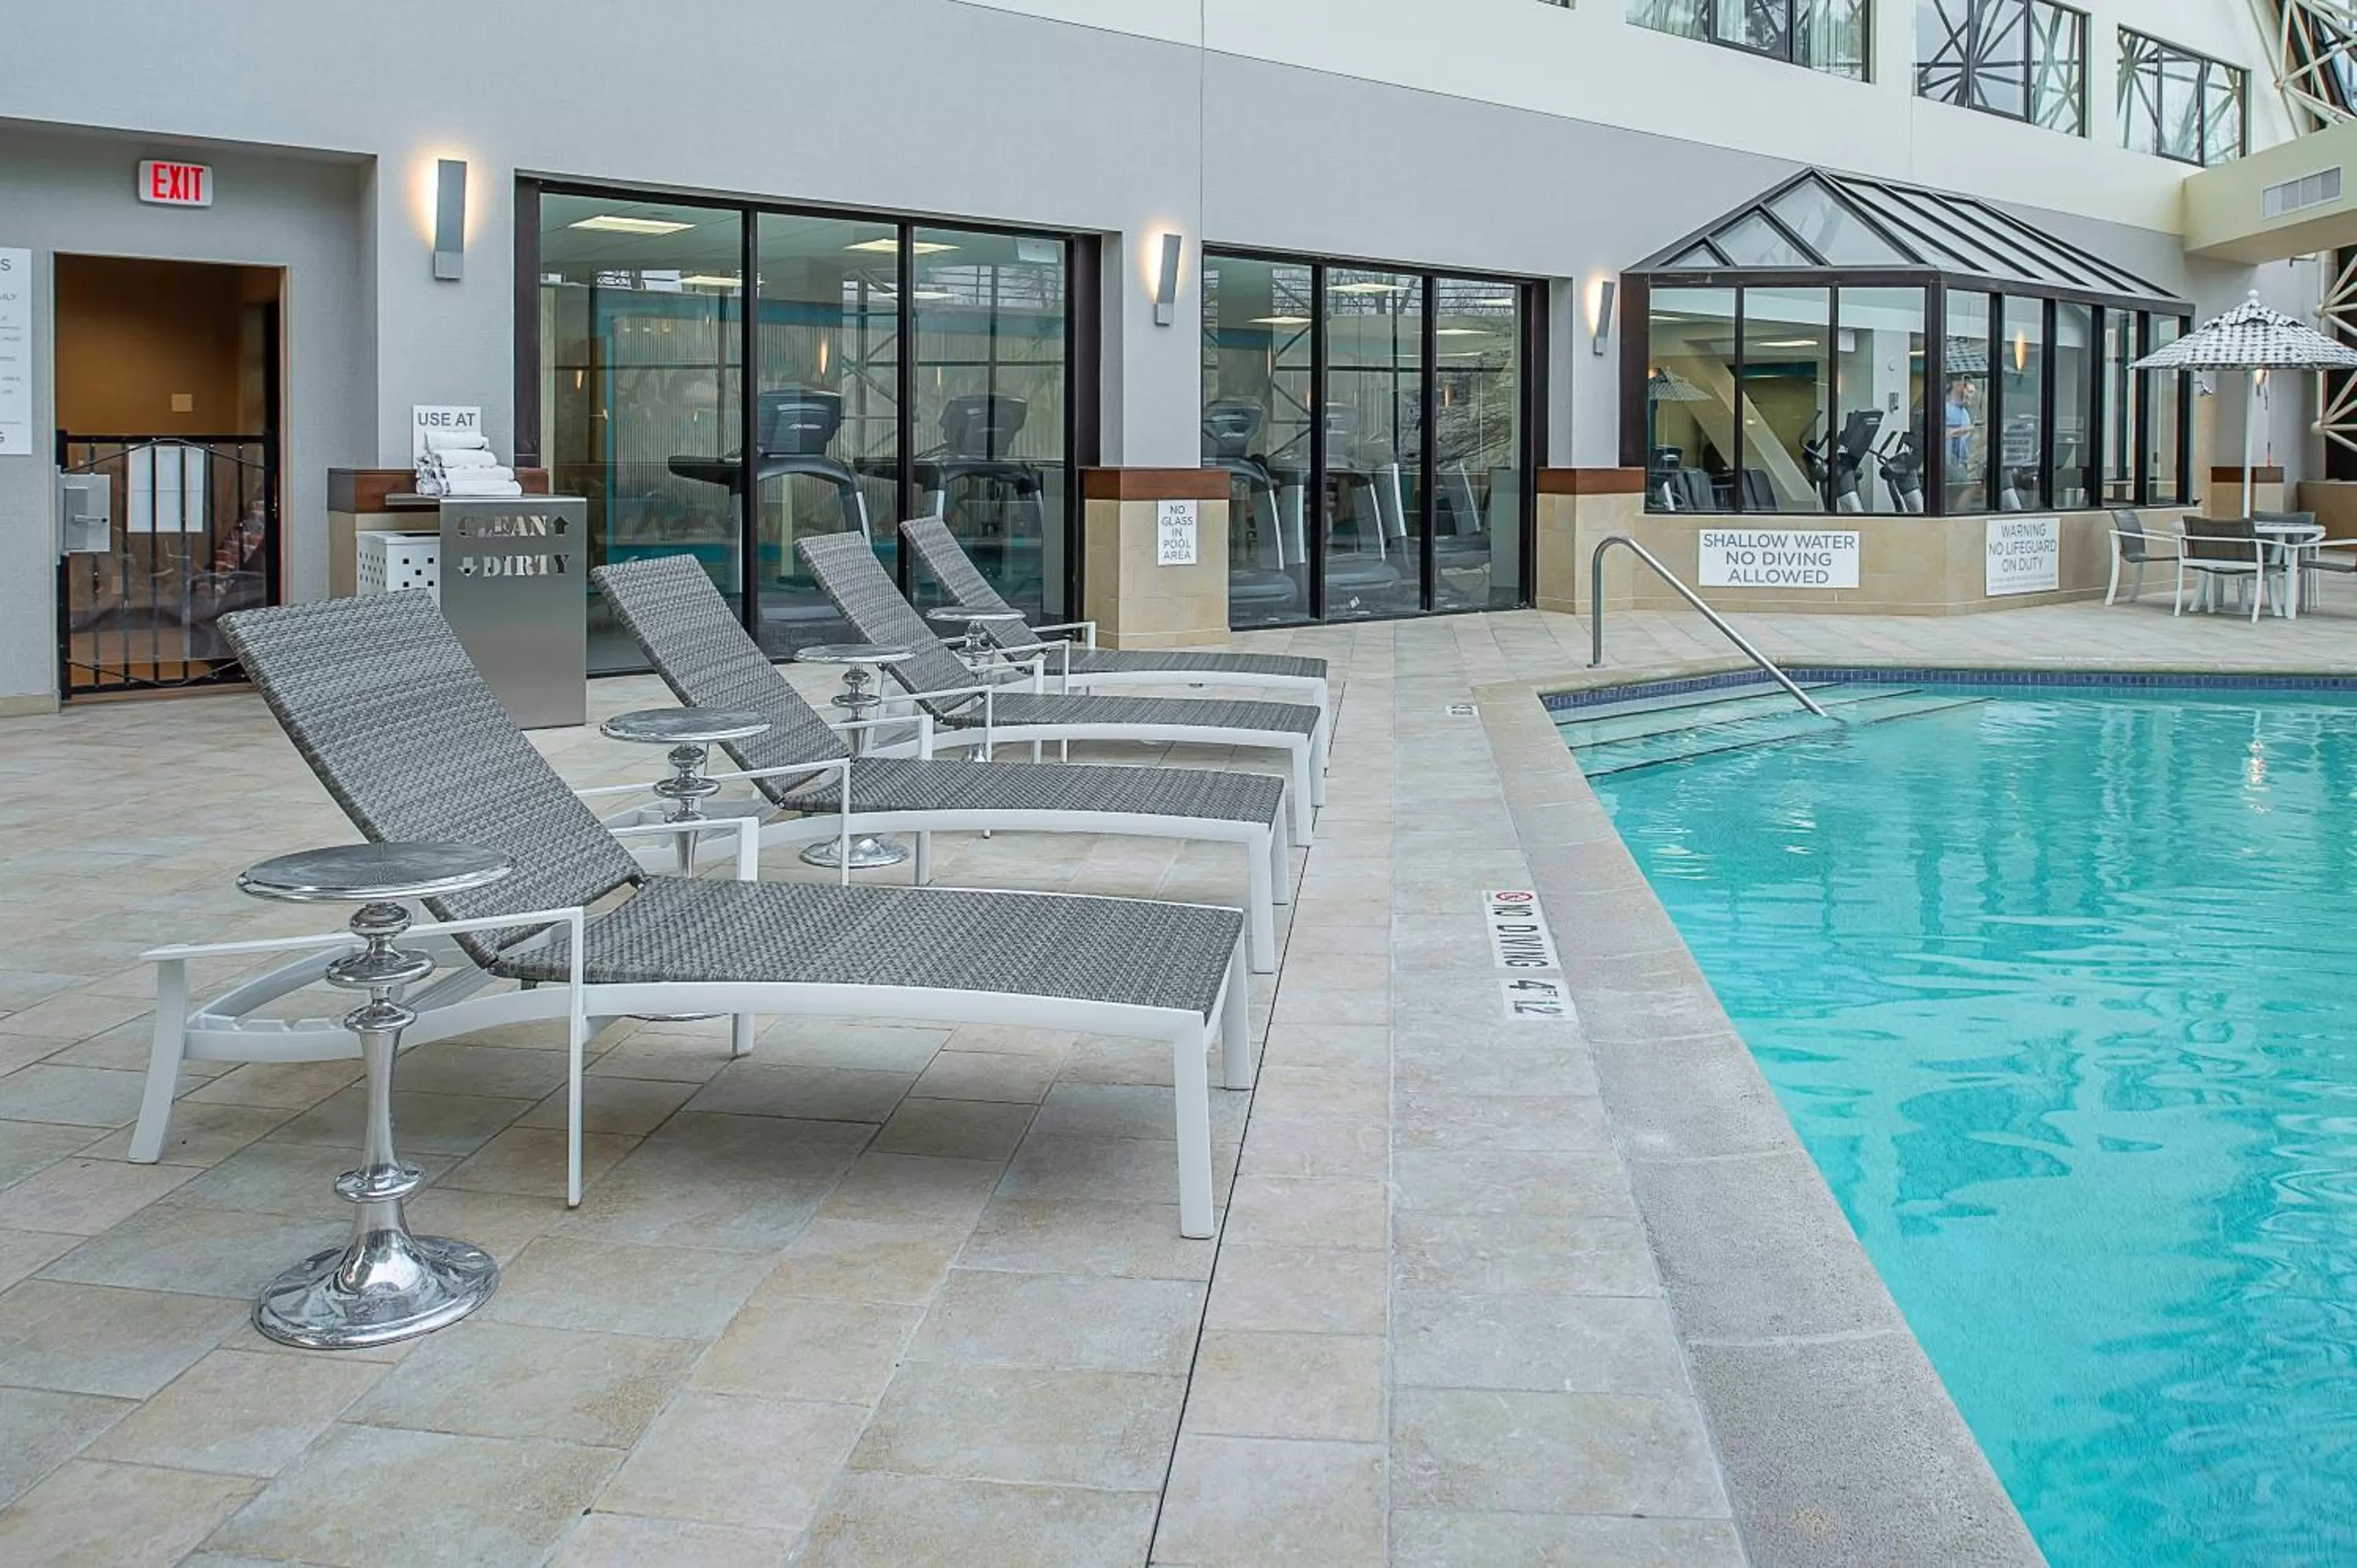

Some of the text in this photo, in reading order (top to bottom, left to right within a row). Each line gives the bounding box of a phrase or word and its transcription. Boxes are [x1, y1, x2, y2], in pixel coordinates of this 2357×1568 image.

[152, 163, 203, 202] EXIT
[418, 412, 475, 426] USE AT
[1170, 505, 1186, 515] NO
[456, 514, 548, 538] CLEAN
[1162, 516, 1193, 526] GLASS
[1171, 528, 1182, 537] IN
[2001, 522, 2047, 538] WARNING
[1164, 538, 1191, 548] POOL
[1703, 533, 1855, 549] SHALLOW WATER
[1989, 540, 2057, 556] NO LIFEGUARD
[1164, 551, 1191, 559] AREA
[1726, 551, 1831, 566] NO DIVING
[482, 553, 572, 577] DIRTY
[2001, 555, 2044, 572] ON DUTY
[1728, 569, 1829, 584] ALLOWED
[1492, 904, 1549, 967] NO DIVING
